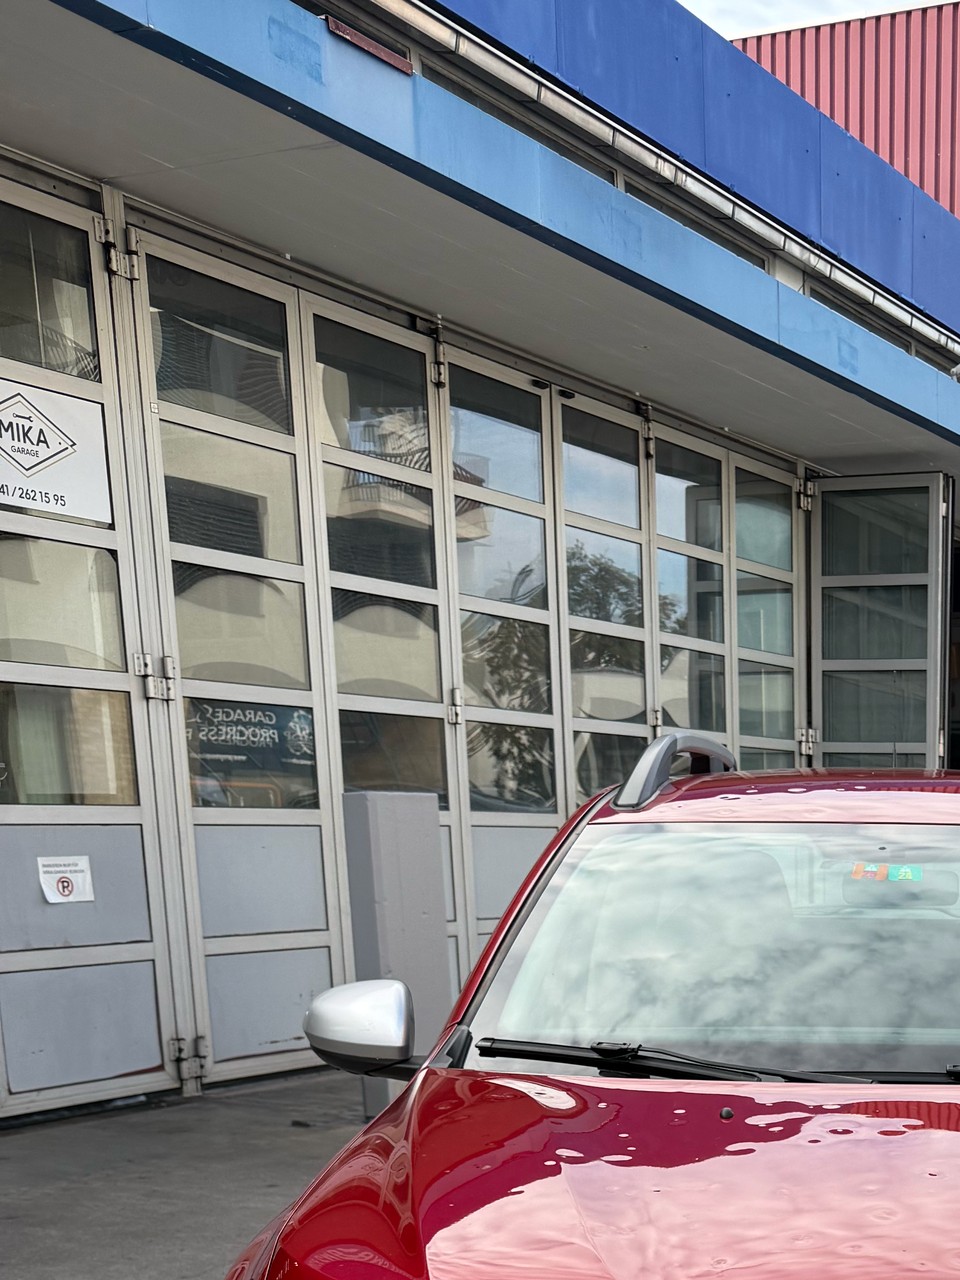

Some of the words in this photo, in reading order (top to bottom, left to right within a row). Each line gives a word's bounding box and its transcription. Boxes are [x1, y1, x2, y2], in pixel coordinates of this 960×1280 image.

[0, 419, 50, 449] MIKA
[10, 445, 39, 458] GARAGE
[18, 487, 37, 501] 262
[40, 491, 51, 504] 15
[53, 494, 66, 507] 95
